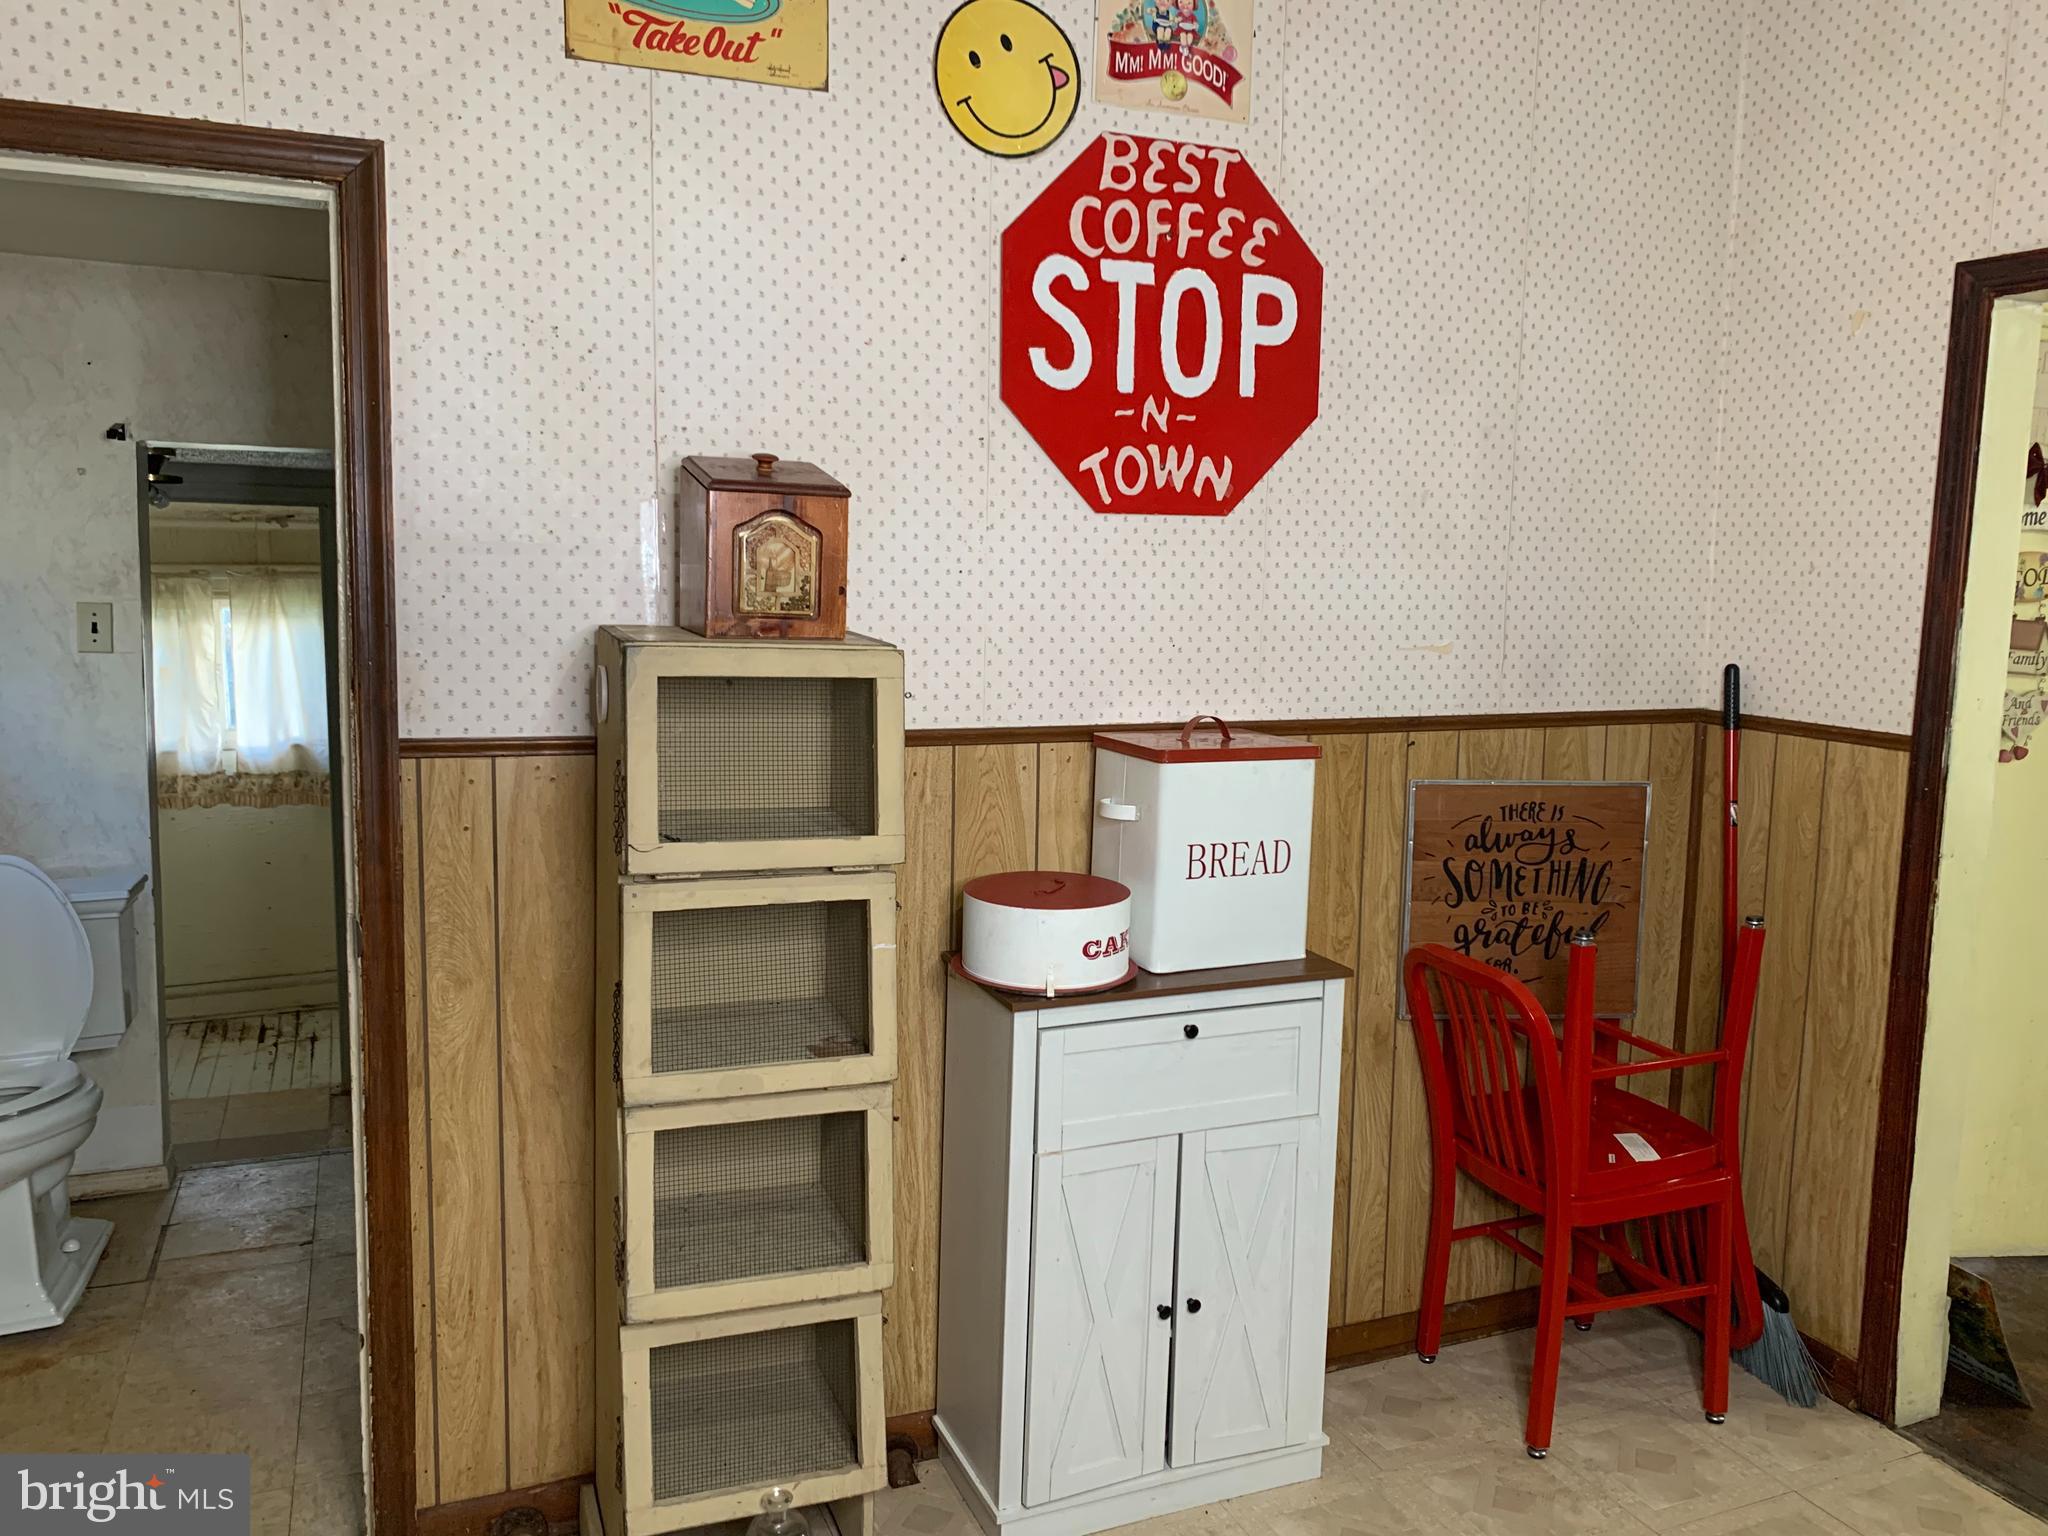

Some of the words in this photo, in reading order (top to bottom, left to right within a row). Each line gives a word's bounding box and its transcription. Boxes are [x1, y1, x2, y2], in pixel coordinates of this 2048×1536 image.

[1181, 54, 1227, 92] GOOD!
[1099, 132, 1241, 198] BEST
[1069, 195, 1280, 267] COFFEE
[1028, 253, 1298, 398] STOP
[1079, 444, 1232, 504] TOWN
[2002, 711, 2041, 727] Friends
[2005, 695, 2035, 712] And
[1500, 802, 1546, 823] THERE
[1551, 804, 1565, 821] IS
[1186, 839, 1292, 880] BREAD
[1465, 815, 1590, 865] always
[1443, 856, 1613, 909] SOMETHING
[1501, 904, 1516, 917] TO
[1522, 902, 1539, 916] BE
